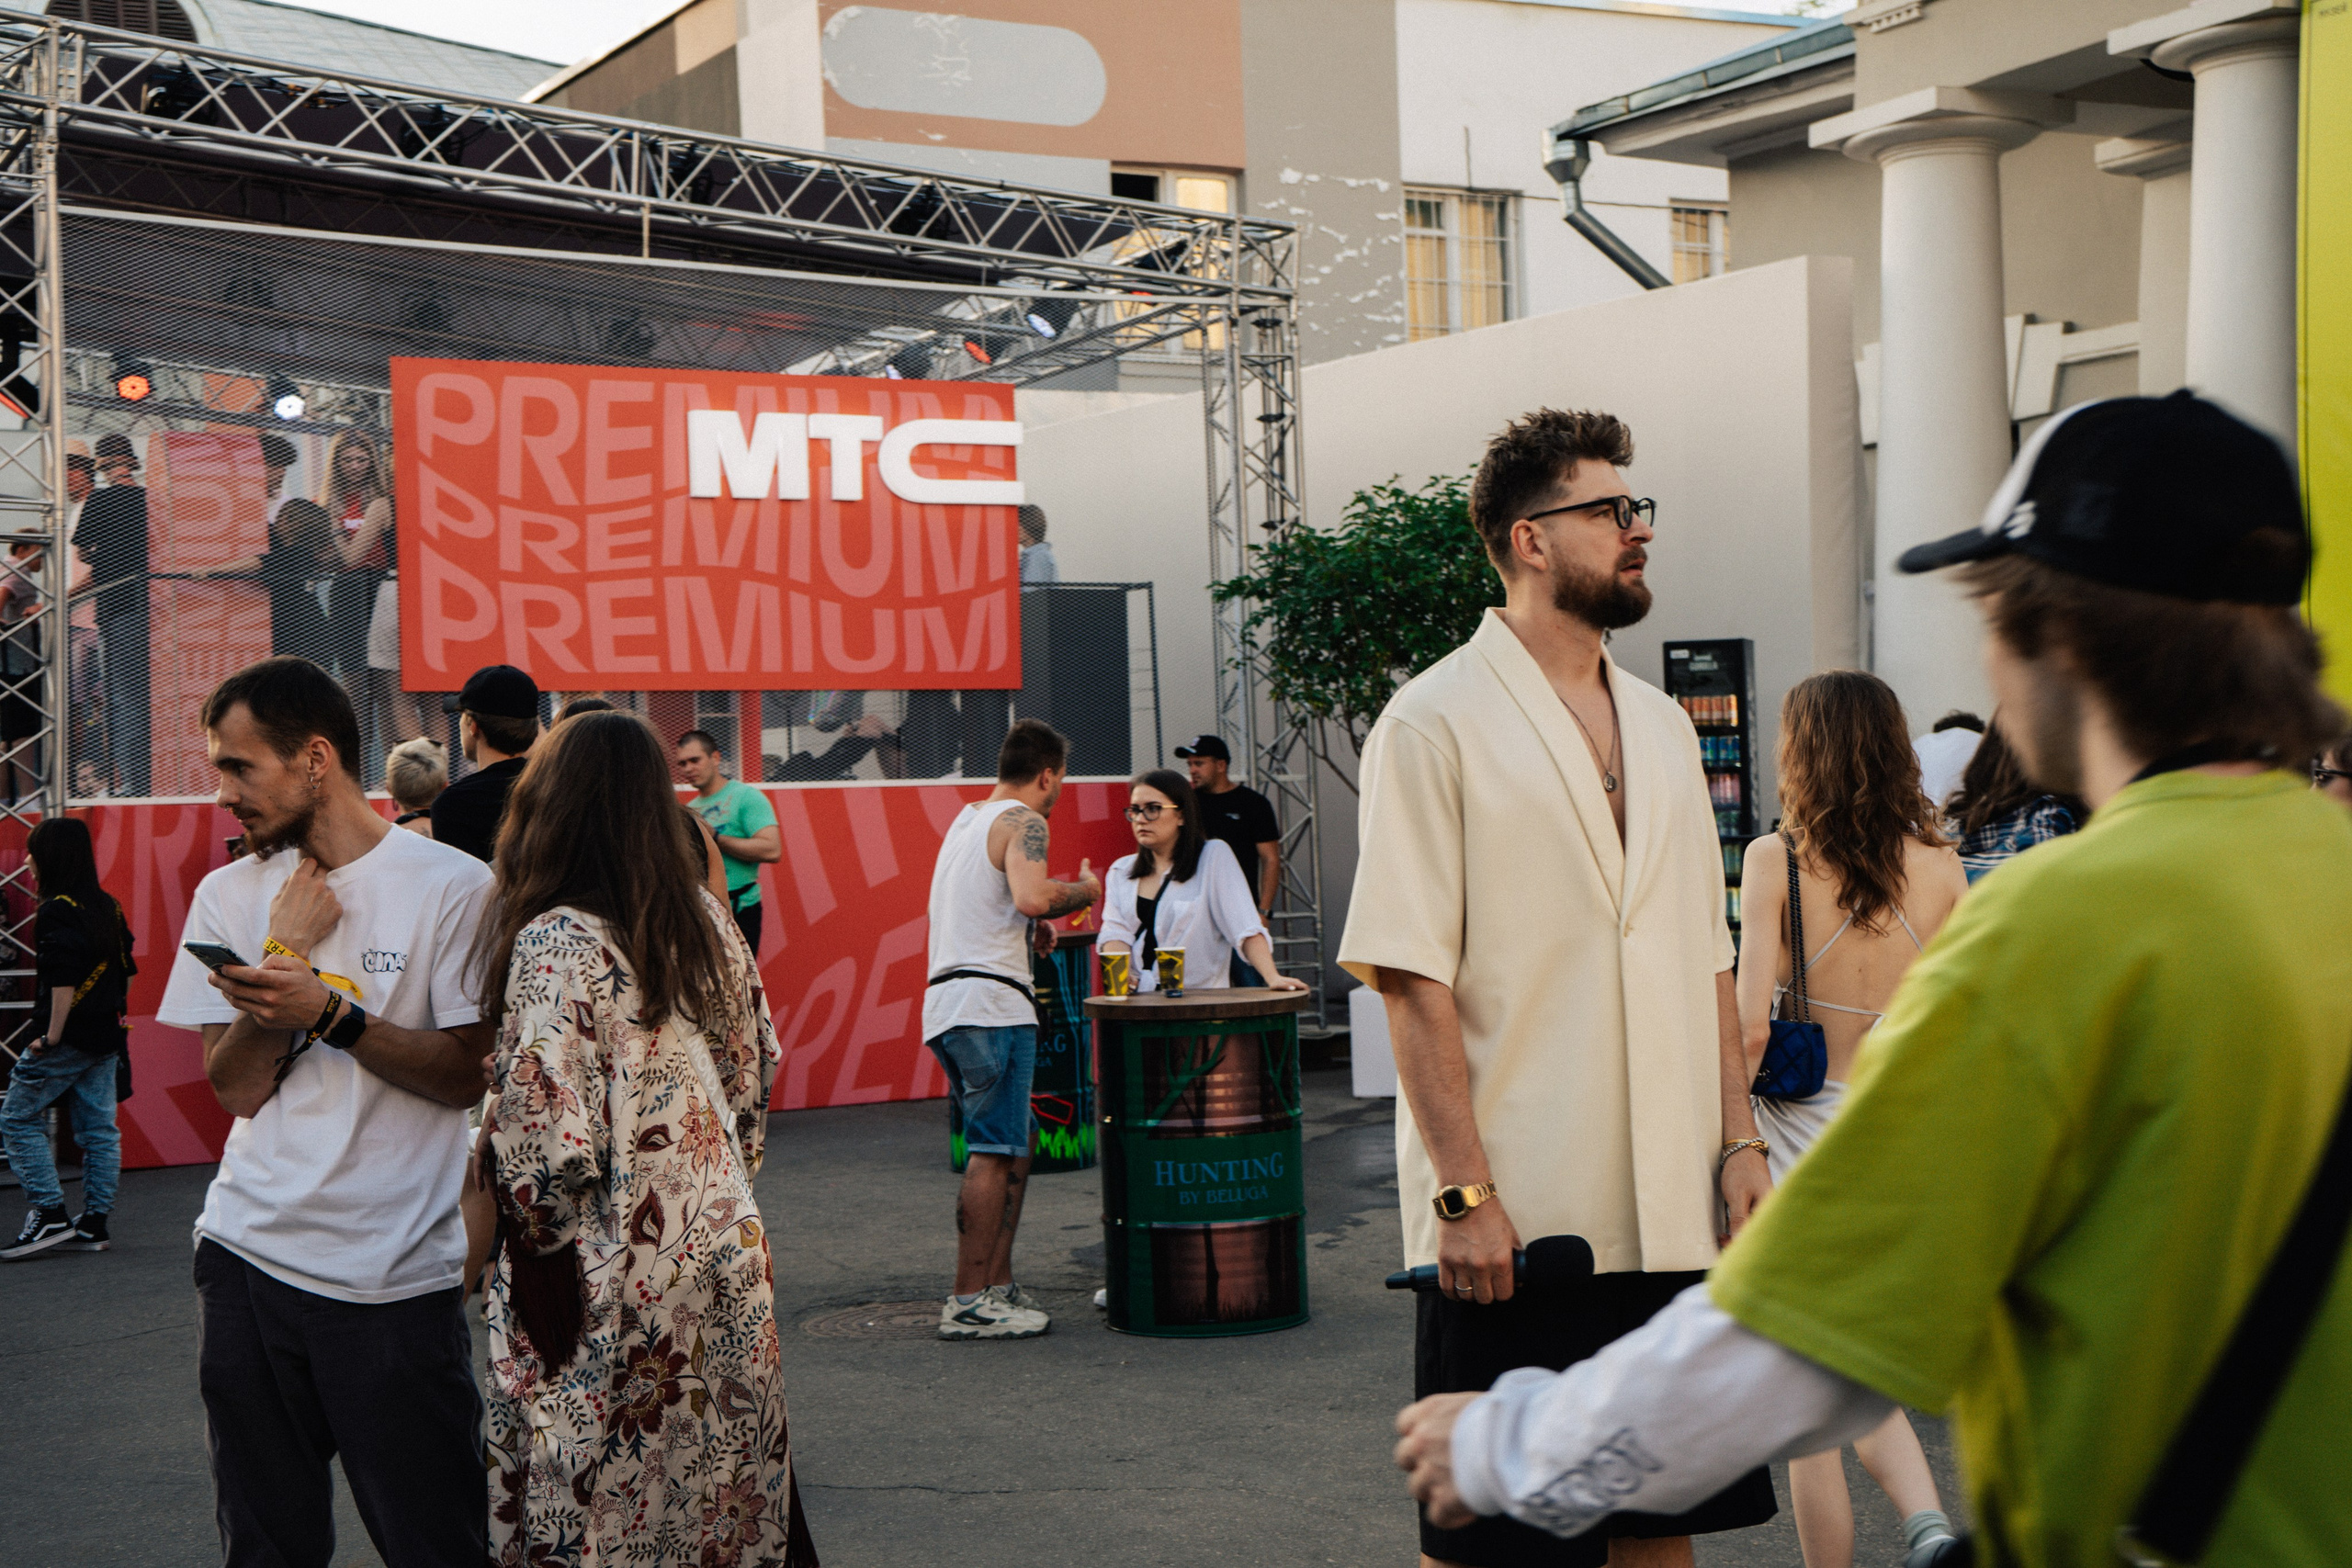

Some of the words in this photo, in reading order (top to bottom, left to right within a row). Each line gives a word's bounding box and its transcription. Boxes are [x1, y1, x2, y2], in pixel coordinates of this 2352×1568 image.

[420, 540, 1009, 674] PREMIUM
[1153, 1152, 1284, 1186] HUNTING
[1179, 1190, 1200, 1205] BY
[1206, 1185, 1269, 1204] BELUGA
